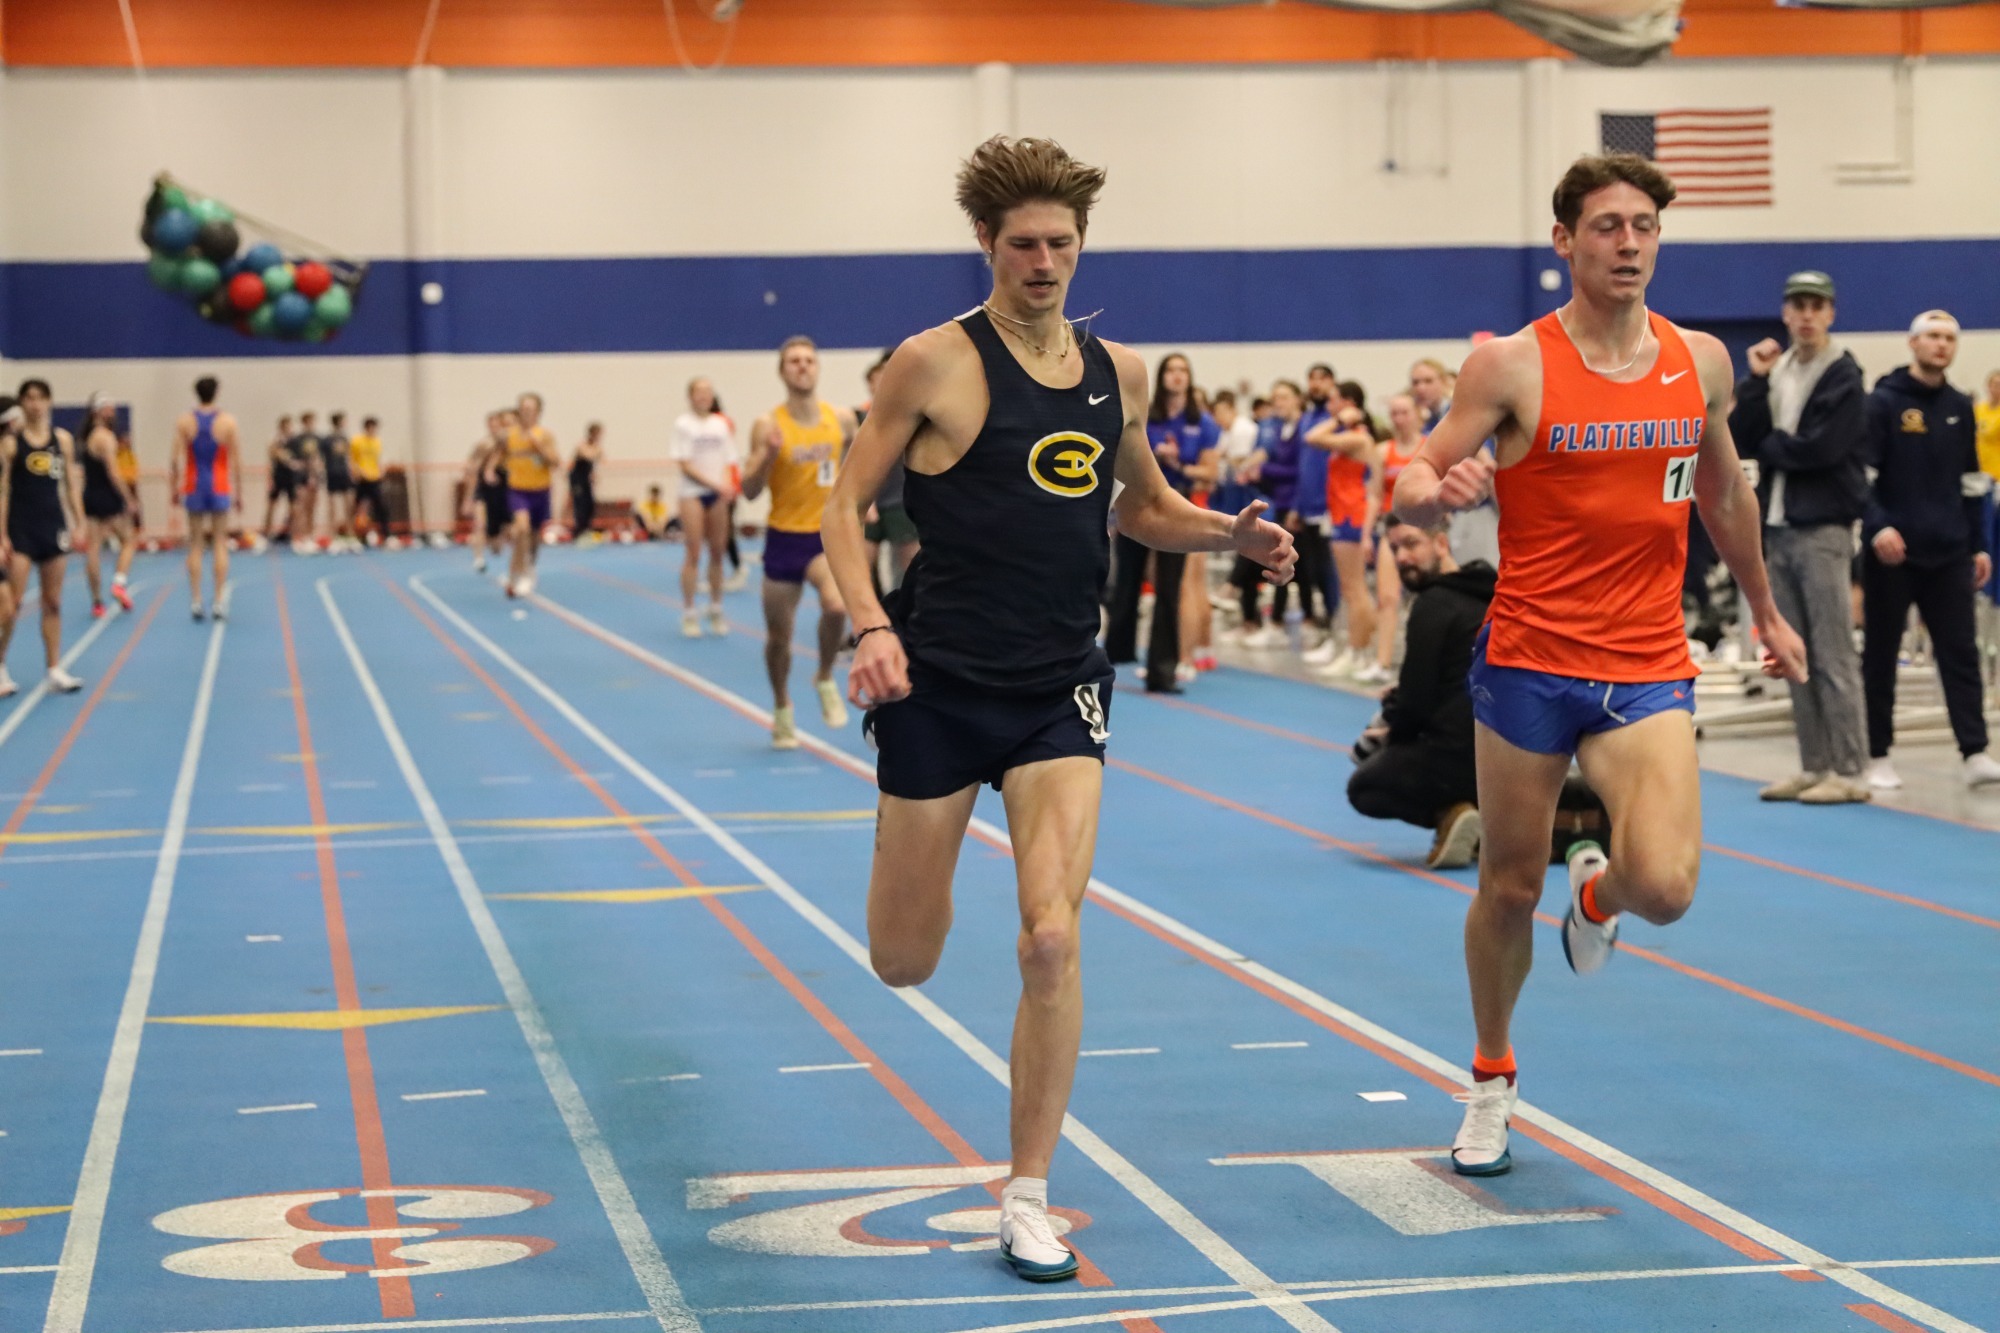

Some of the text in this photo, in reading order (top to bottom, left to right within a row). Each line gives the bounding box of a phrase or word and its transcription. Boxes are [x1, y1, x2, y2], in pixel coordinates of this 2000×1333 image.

[1547, 417, 1703, 453] PLATTEVILLE
[1669, 459, 1695, 499] 10
[151, 1186, 550, 1281] 3
